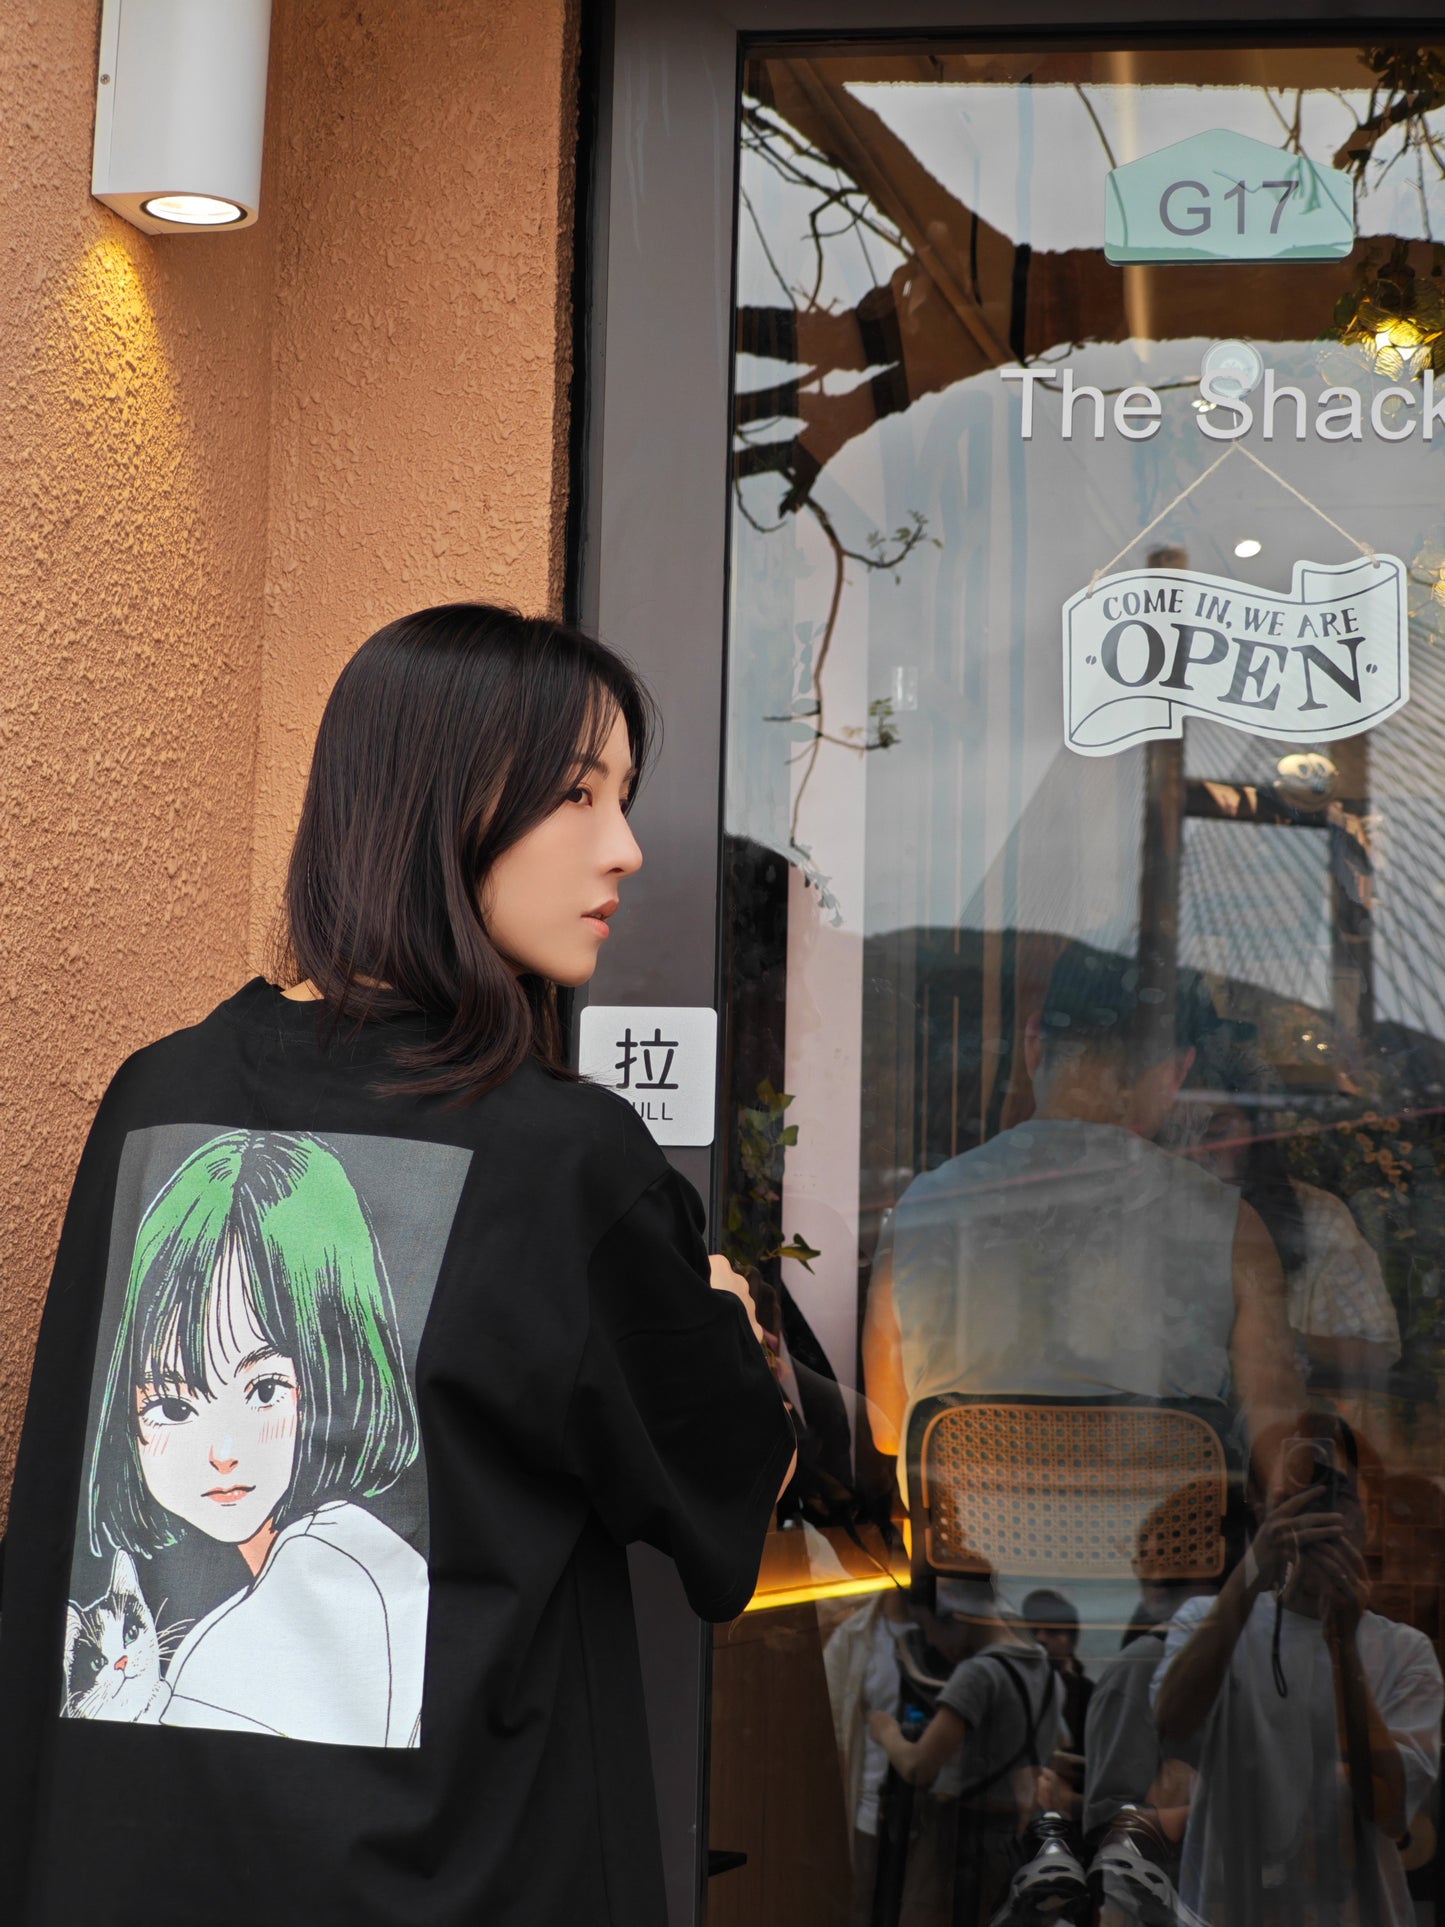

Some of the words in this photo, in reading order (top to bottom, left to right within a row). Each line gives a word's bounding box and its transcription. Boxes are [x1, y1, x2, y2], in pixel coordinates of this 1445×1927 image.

[1159, 180, 1300, 236] G17
[1001, 367, 1162, 442] The
[1195, 367, 1445, 443] Shack
[1102, 588, 1184, 621] COME
[1195, 592, 1233, 630] IN,
[1243, 606, 1286, 637] WE
[1297, 607, 1360, 638] ARE
[1101, 618, 1367, 712] OPEN
[615, 1027, 680, 1090] 拉
